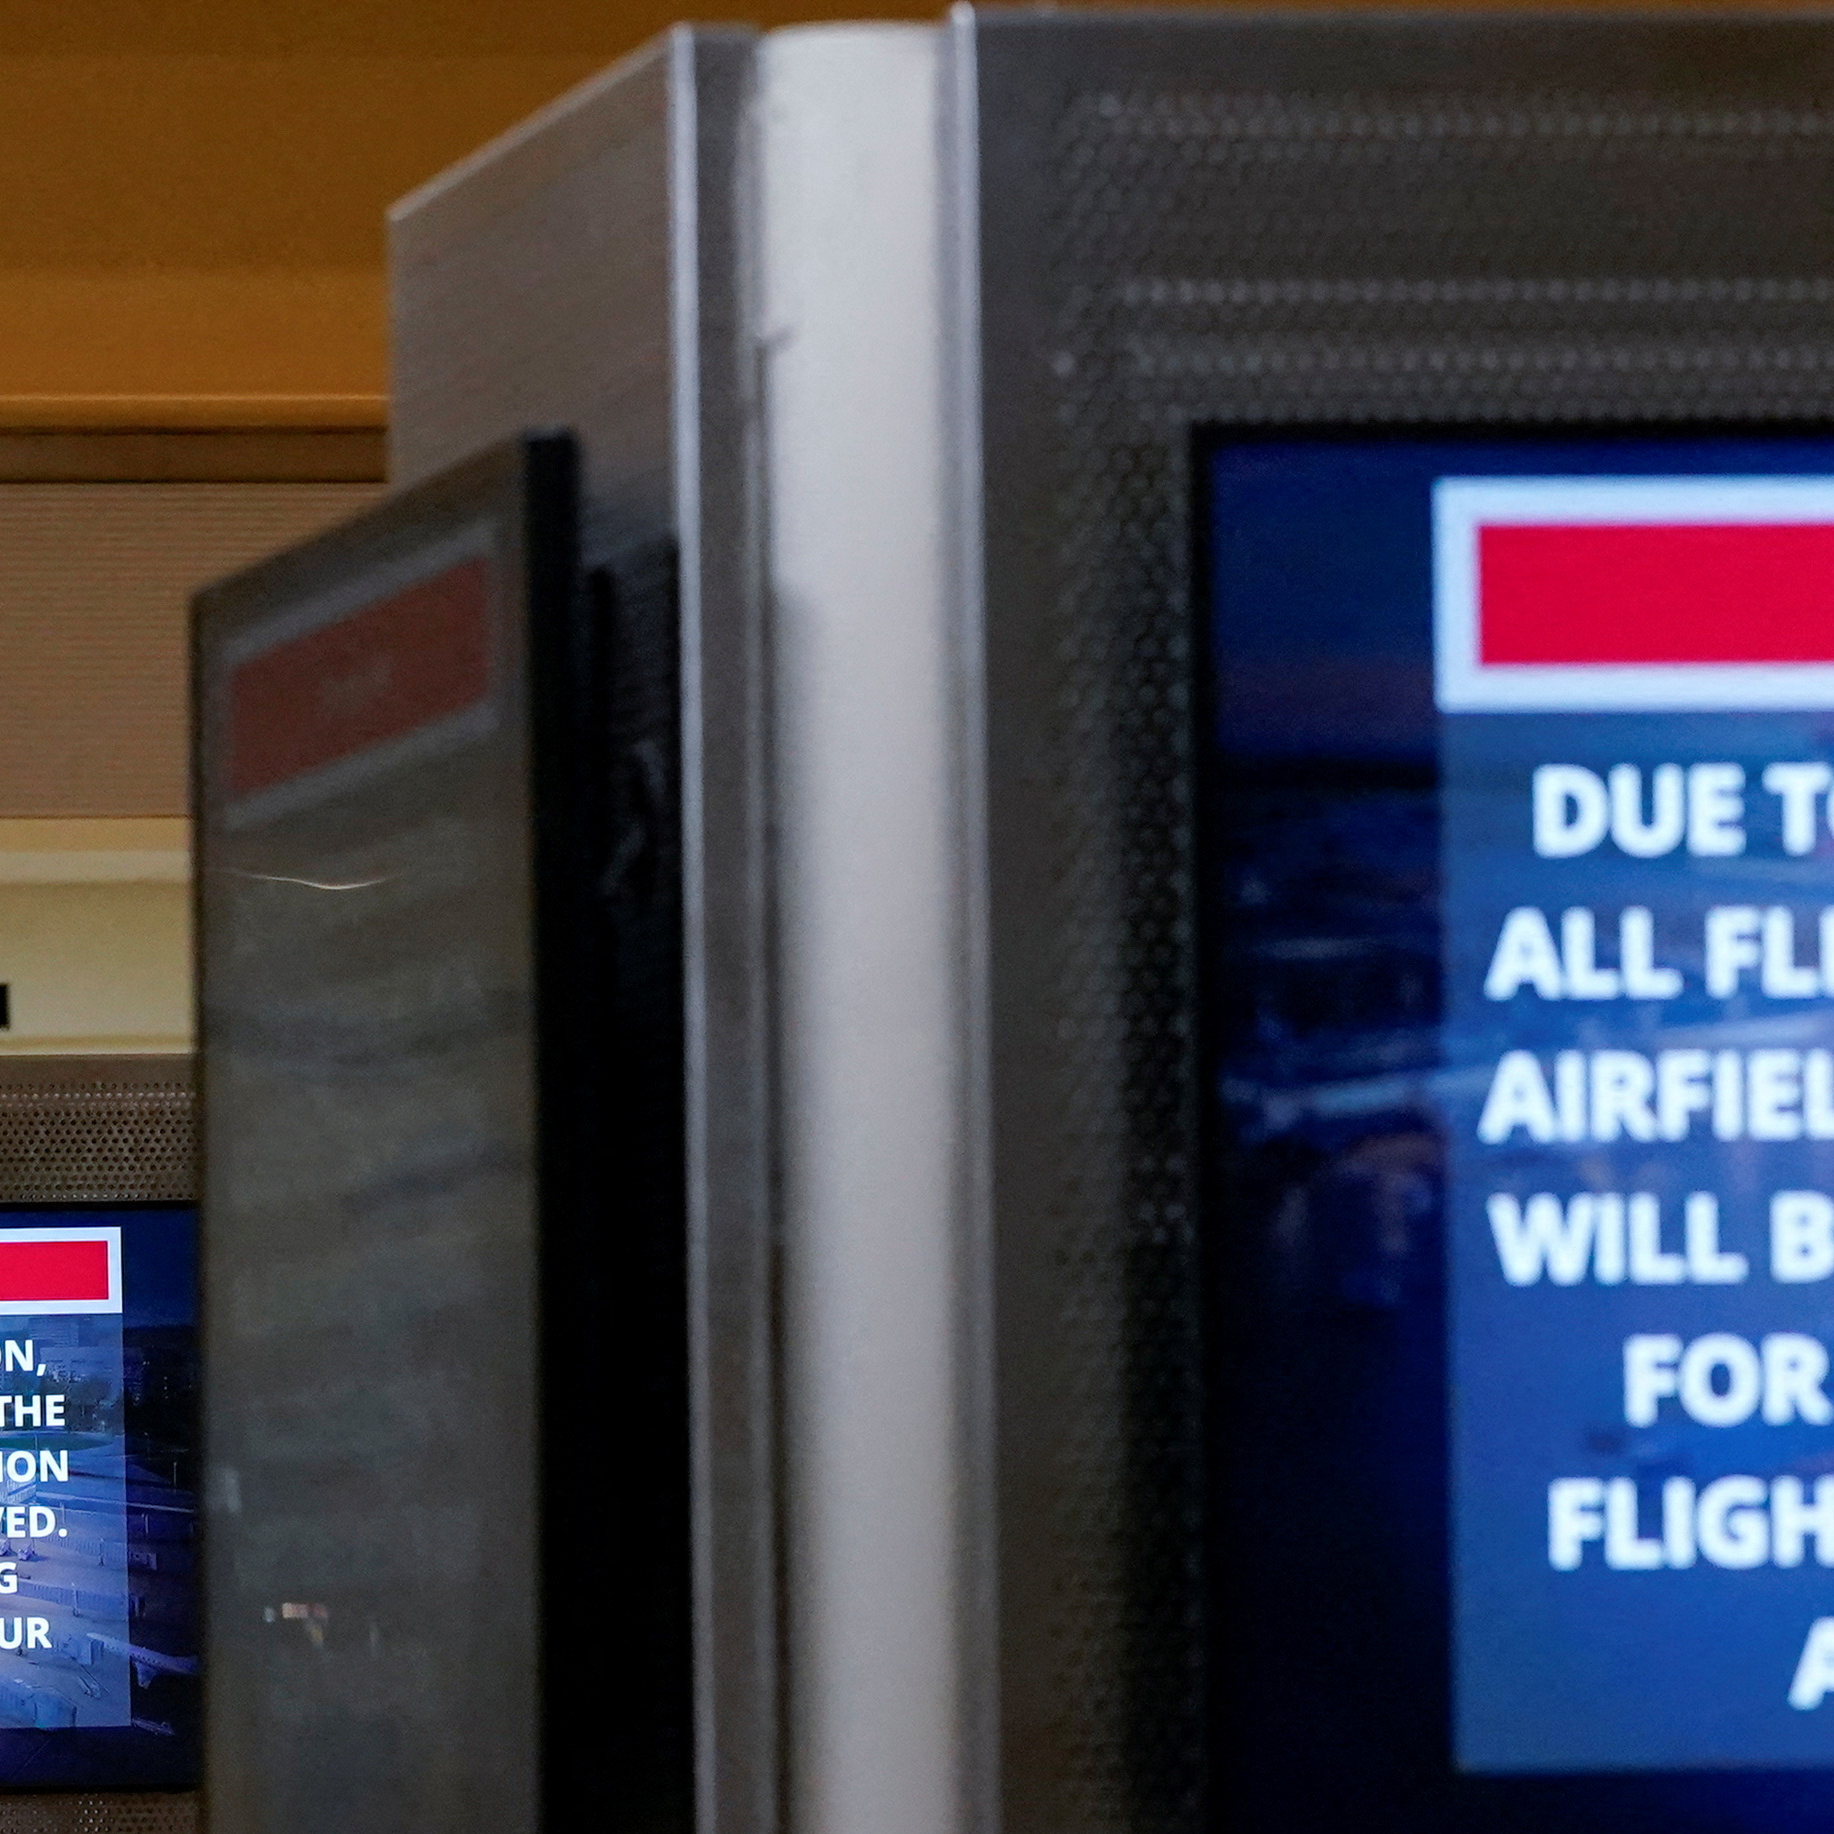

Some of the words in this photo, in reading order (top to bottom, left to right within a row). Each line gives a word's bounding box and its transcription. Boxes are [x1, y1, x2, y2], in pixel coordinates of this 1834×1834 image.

[1533, 763, 1746, 858] DUE
[1486, 906, 1683, 1000] ALL
[1488, 1191, 1749, 1286] WILL
[1624, 1333, 1831, 1426] FOR
